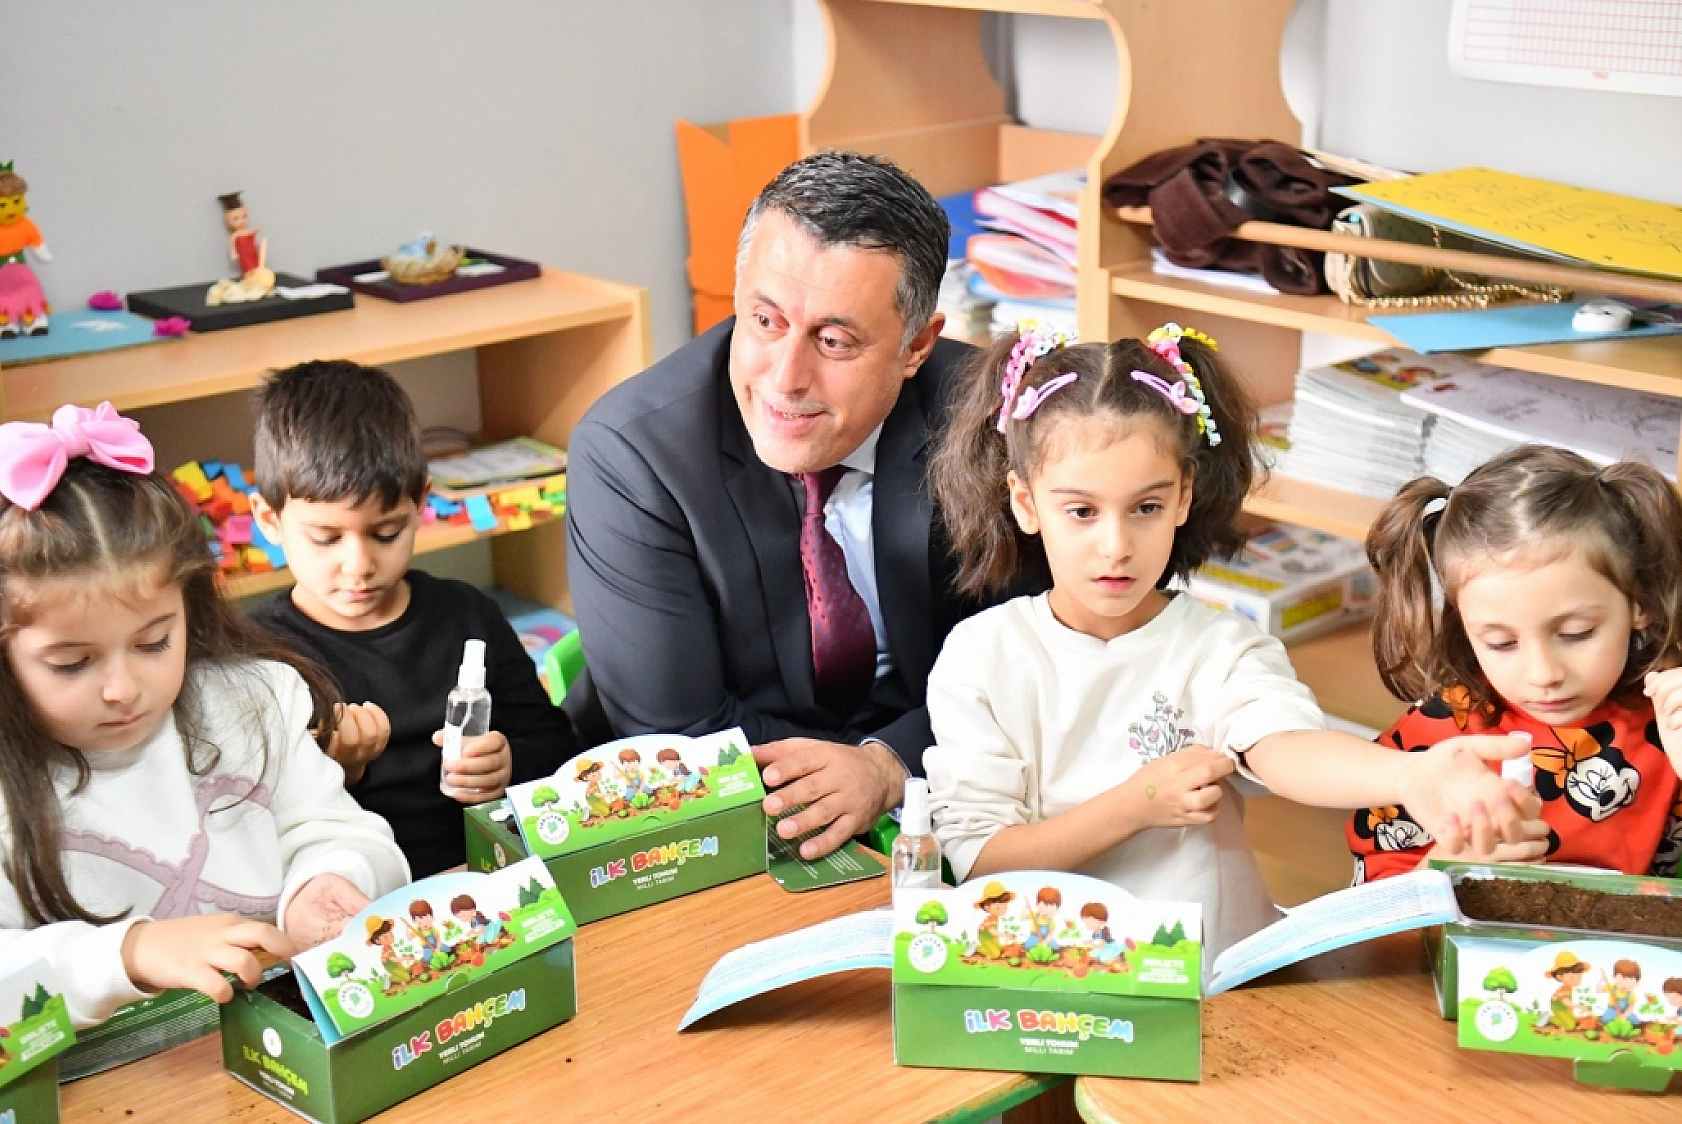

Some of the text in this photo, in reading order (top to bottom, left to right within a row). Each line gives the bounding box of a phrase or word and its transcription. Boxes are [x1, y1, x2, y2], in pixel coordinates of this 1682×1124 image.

[630, 835, 719, 872] BAHÇEM
[435, 988, 526, 1044] BAHÇEM
[1017, 1009, 1133, 1042] BAHÇEM
